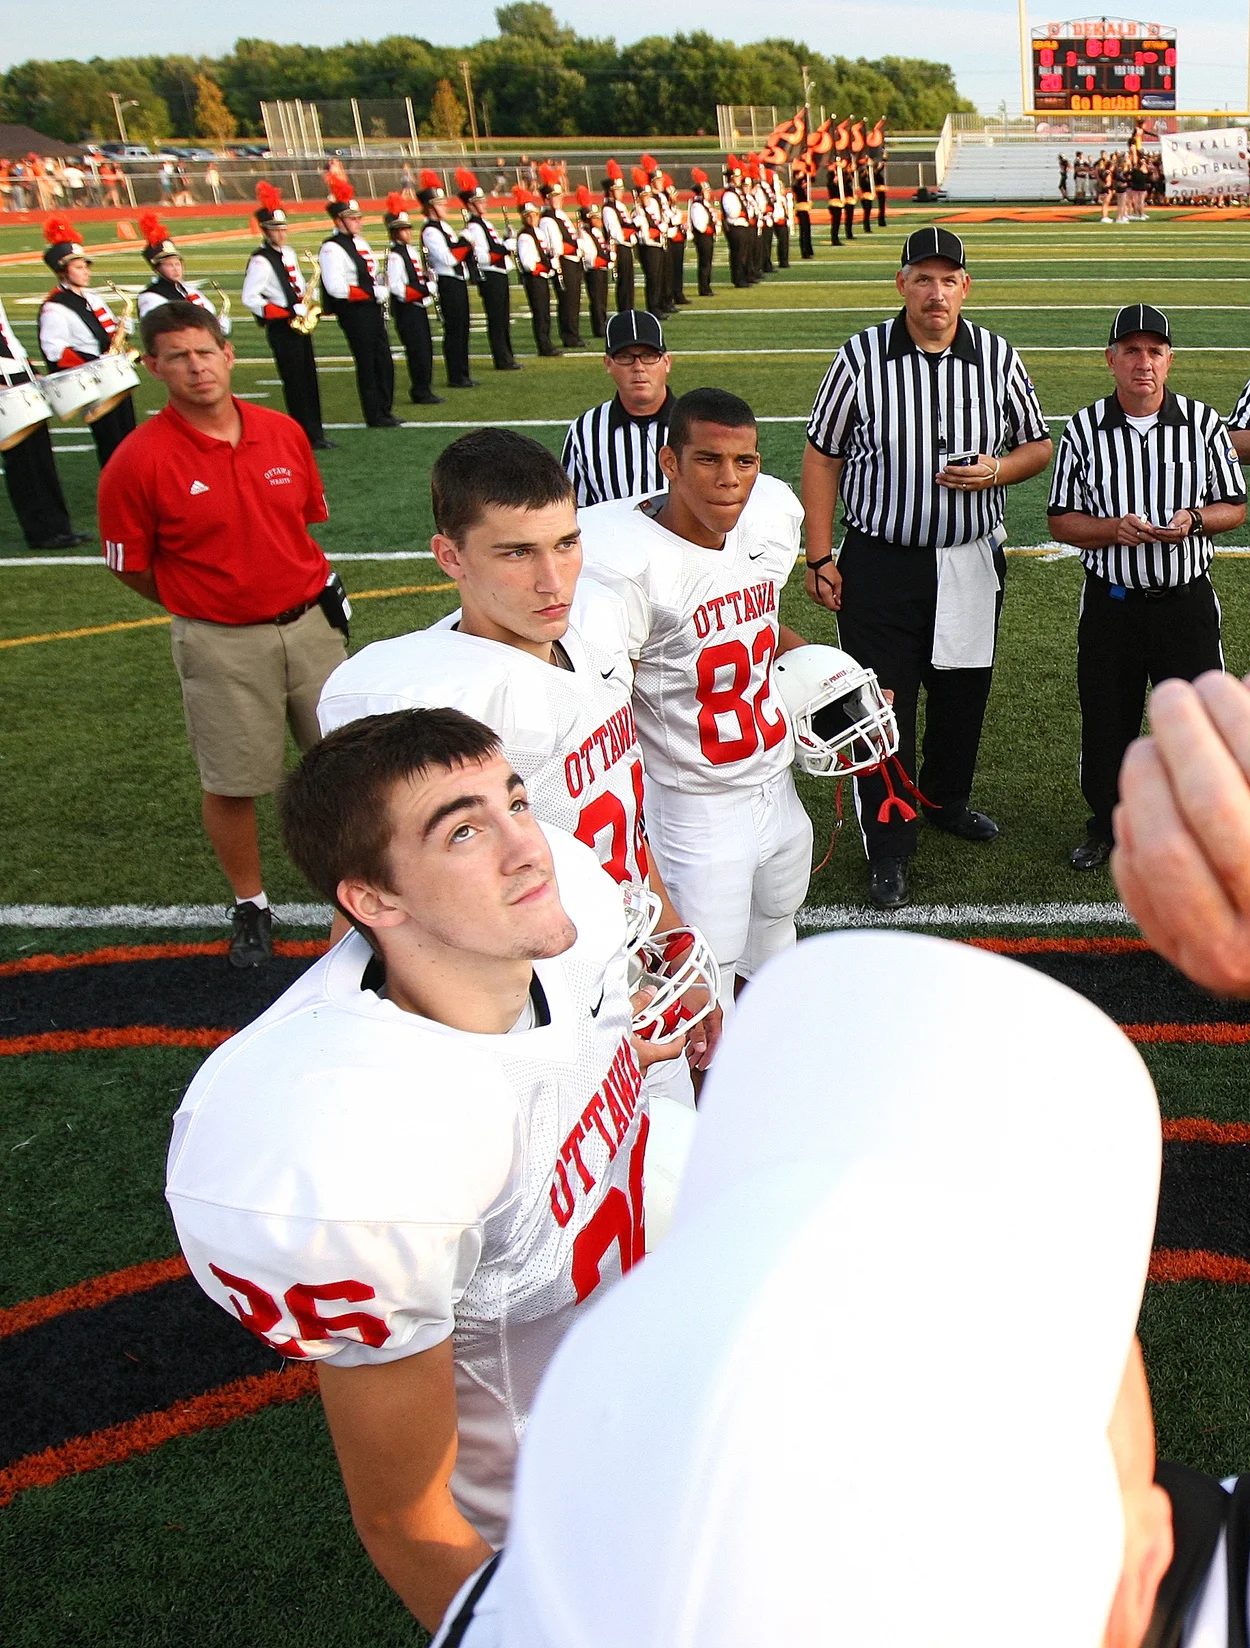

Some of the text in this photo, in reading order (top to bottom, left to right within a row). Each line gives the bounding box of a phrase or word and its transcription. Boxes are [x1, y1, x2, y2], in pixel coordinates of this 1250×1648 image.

[1073, 23, 1137, 36] DEKALB
[1071, 95, 1091, 110] Go
[1172, 135, 1244, 152] DEKALB
[1172, 162, 1245, 179] FOOTBALL
[1172, 183, 1242, 198] 2011-2012
[264, 467, 292, 479] OTTAWA
[693, 580, 777, 639] OTTAWA
[695, 625, 788, 766] 82
[208, 1262, 392, 1358] 26
